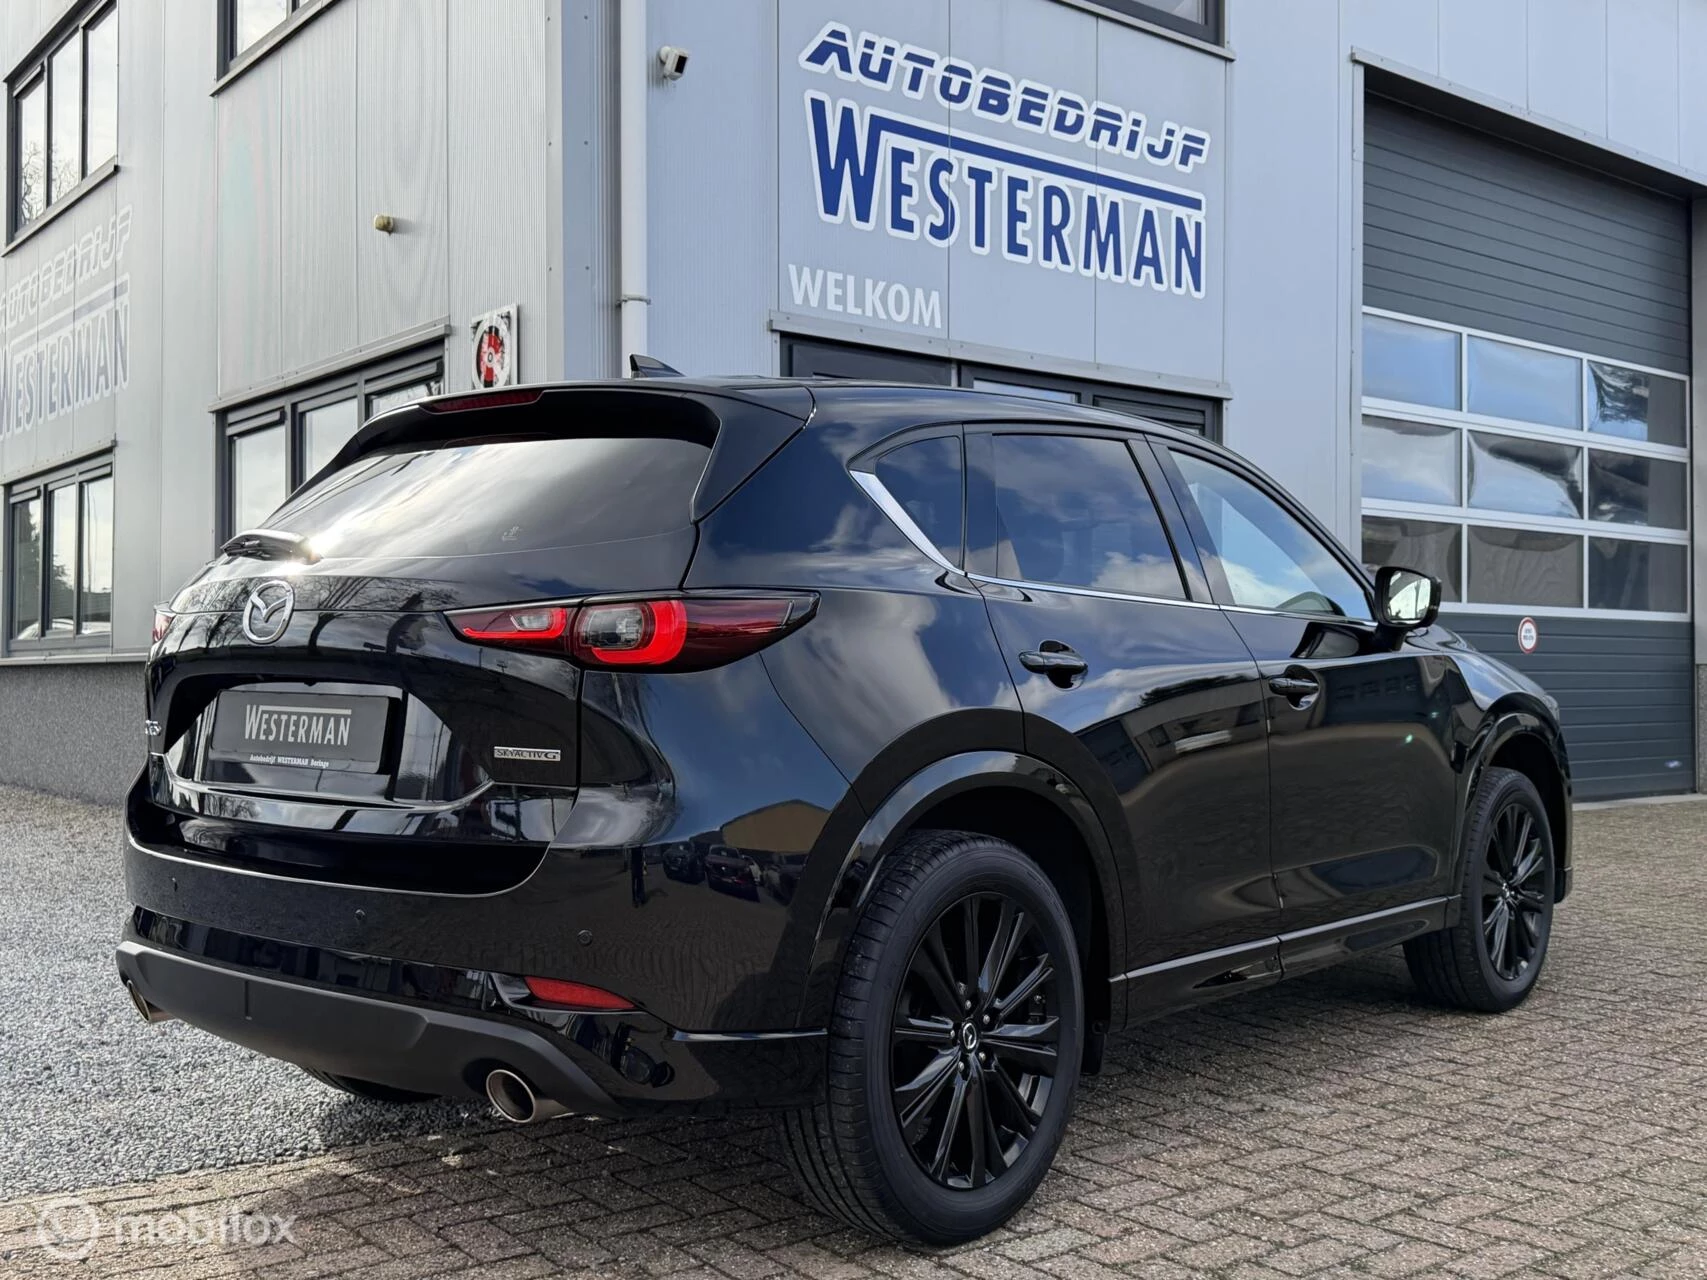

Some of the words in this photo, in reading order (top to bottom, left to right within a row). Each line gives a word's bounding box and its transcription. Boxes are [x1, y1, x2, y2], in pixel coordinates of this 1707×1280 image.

[801, 22, 1210, 172] AUTOBEDRIJF
[805, 91, 1205, 298] WESTERMAN
[788, 264, 942, 328] WELKOM
[245, 704, 351, 746] WESTERMAN
[277, 756, 308, 766] WESTERMAN
